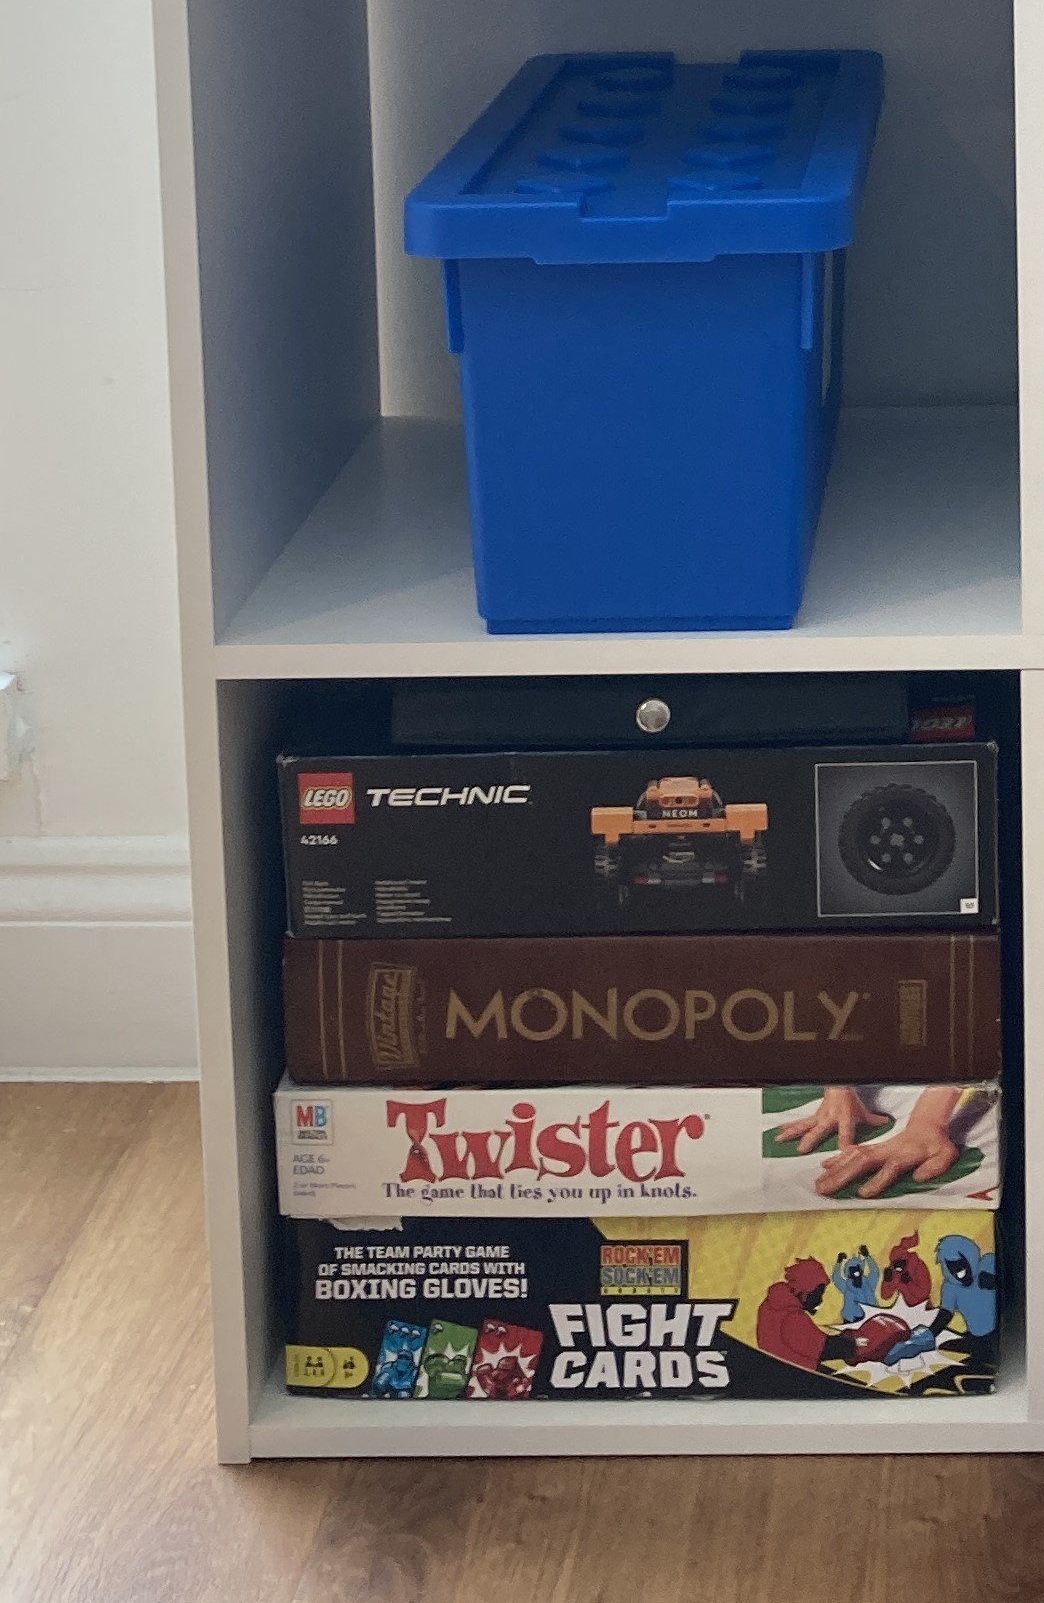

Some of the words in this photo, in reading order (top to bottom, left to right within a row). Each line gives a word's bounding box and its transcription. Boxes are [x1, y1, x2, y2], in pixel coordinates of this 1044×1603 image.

[302, 787, 351, 809] LEGO
[366, 784, 530, 807] TECHNIC
[445, 987, 859, 1042] MONOPOLY
[296, 1105, 327, 1127] MB
[386, 1098, 705, 1185] Twister
[293, 1165, 325, 1175] EDAD
[382, 1182, 415, 1199] The
[420, 1185, 465, 1205] game
[470, 1182, 502, 1199] that
[510, 1182, 542, 1199] ties
[547, 1186, 583, 1203] you
[588, 1187, 611, 1204] up
[617, 1183, 635, 1198] in
[640, 1182, 697, 1198] knots.
[335, 1247, 363, 1259] THE
[367, 1246, 410, 1259] TEAM
[413, 1246, 462, 1258] PARTY
[465, 1245, 509, 1258] GAME
[318, 1263, 338, 1276] OF
[341, 1262, 426, 1275] SMACKING
[429, 1262, 481, 1275] CARDS
[484, 1262, 525, 1275] WITH
[315, 1278, 417, 1299] BOXING
[422, 1277, 528, 1298] GLOVES!
[549, 1303, 735, 1348] FIGHT
[549, 1350, 730, 1389] CARDS
